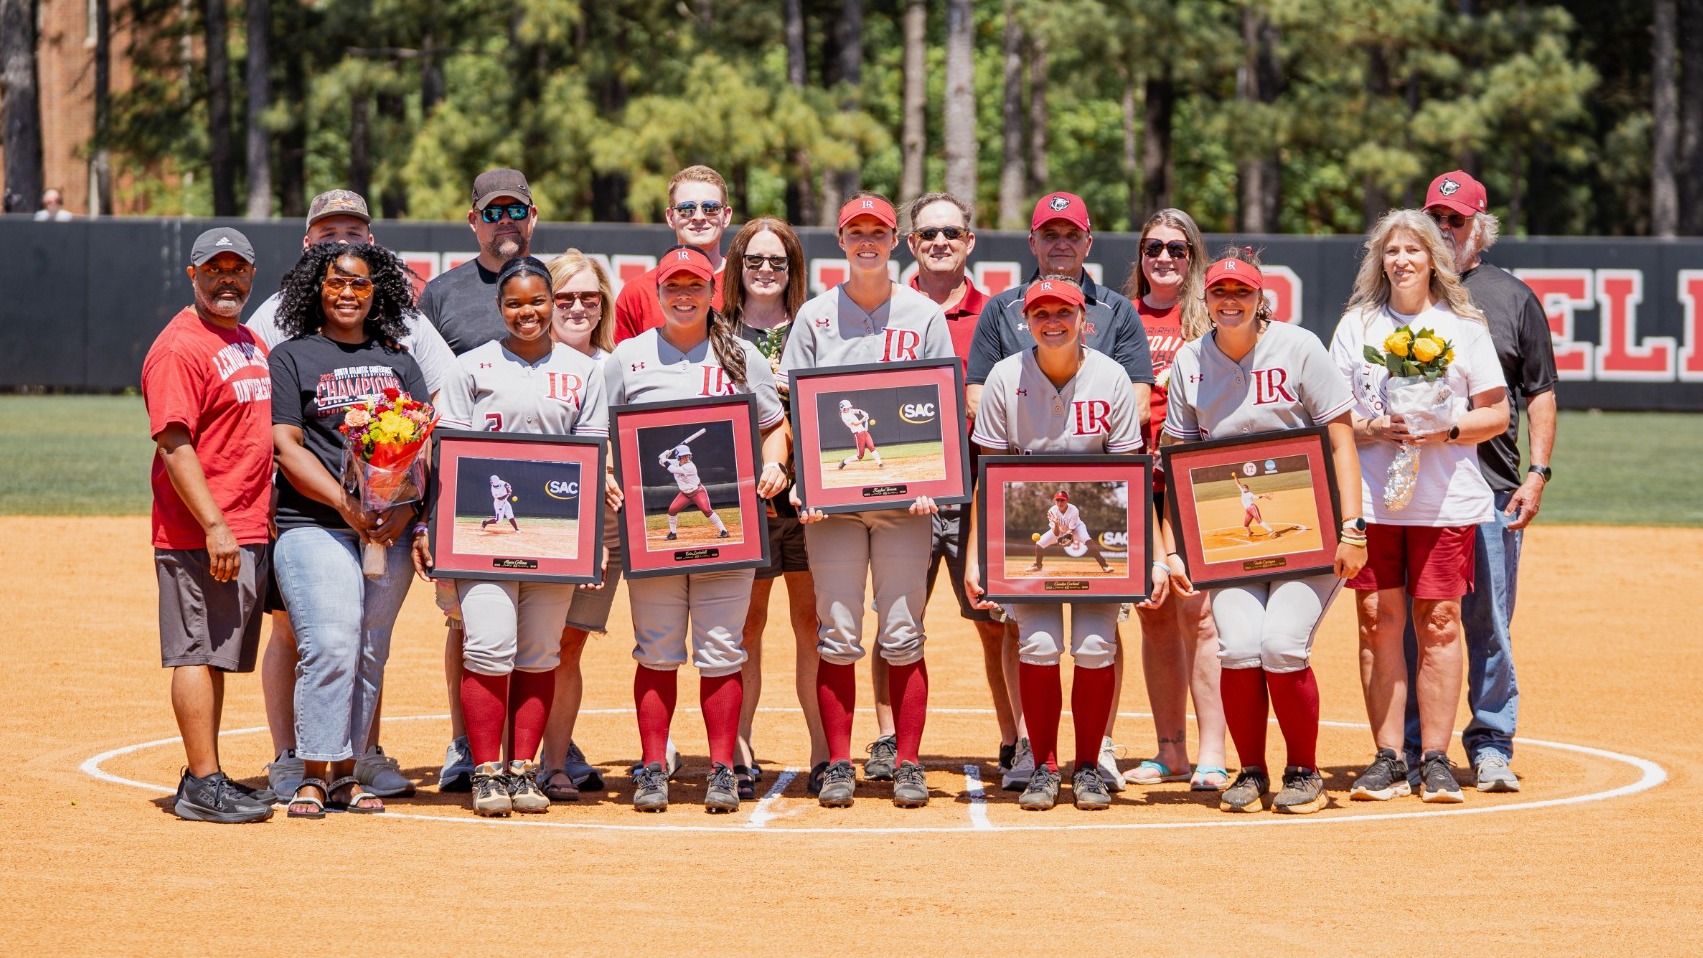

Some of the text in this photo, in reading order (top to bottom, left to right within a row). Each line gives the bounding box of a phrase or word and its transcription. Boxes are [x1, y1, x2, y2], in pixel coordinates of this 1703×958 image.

[861, 200, 874, 209] LR
[879, 327, 922, 362] LR
[545, 371, 583, 411] LR
[1250, 367, 1298, 406] LR
[904, 403, 936, 418] SAC
[1071, 400, 1112, 436] LR
[550, 480, 578, 495] SAC
